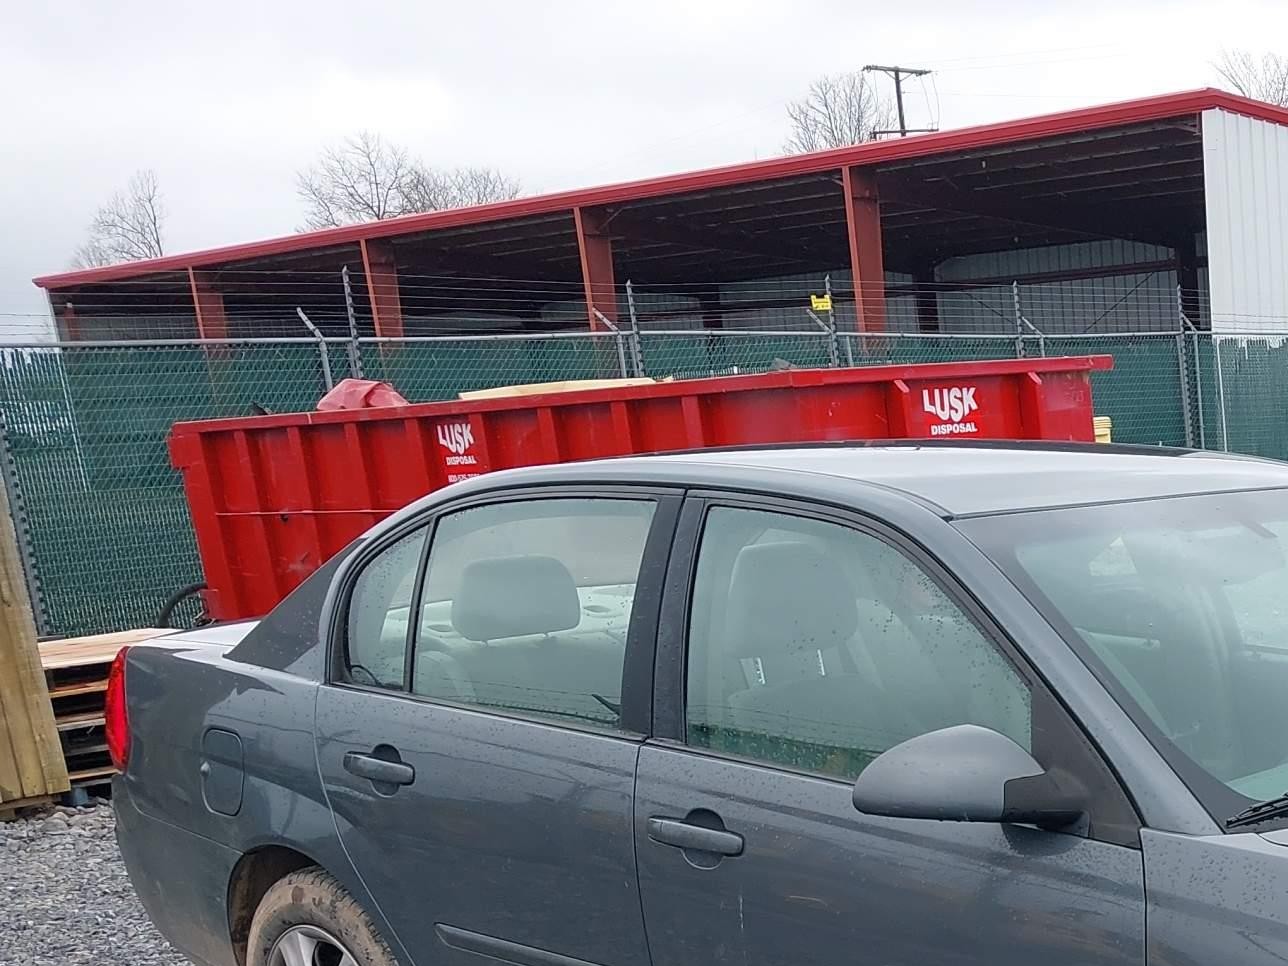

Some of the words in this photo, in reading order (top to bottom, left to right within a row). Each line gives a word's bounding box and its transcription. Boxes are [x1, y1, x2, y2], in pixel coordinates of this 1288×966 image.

[923, 387, 978, 422] LUSK
[437, 423, 475, 455] LUSK
[931, 422, 978, 436] DISPOSAL
[446, 455, 477, 466] DISPOSAL
